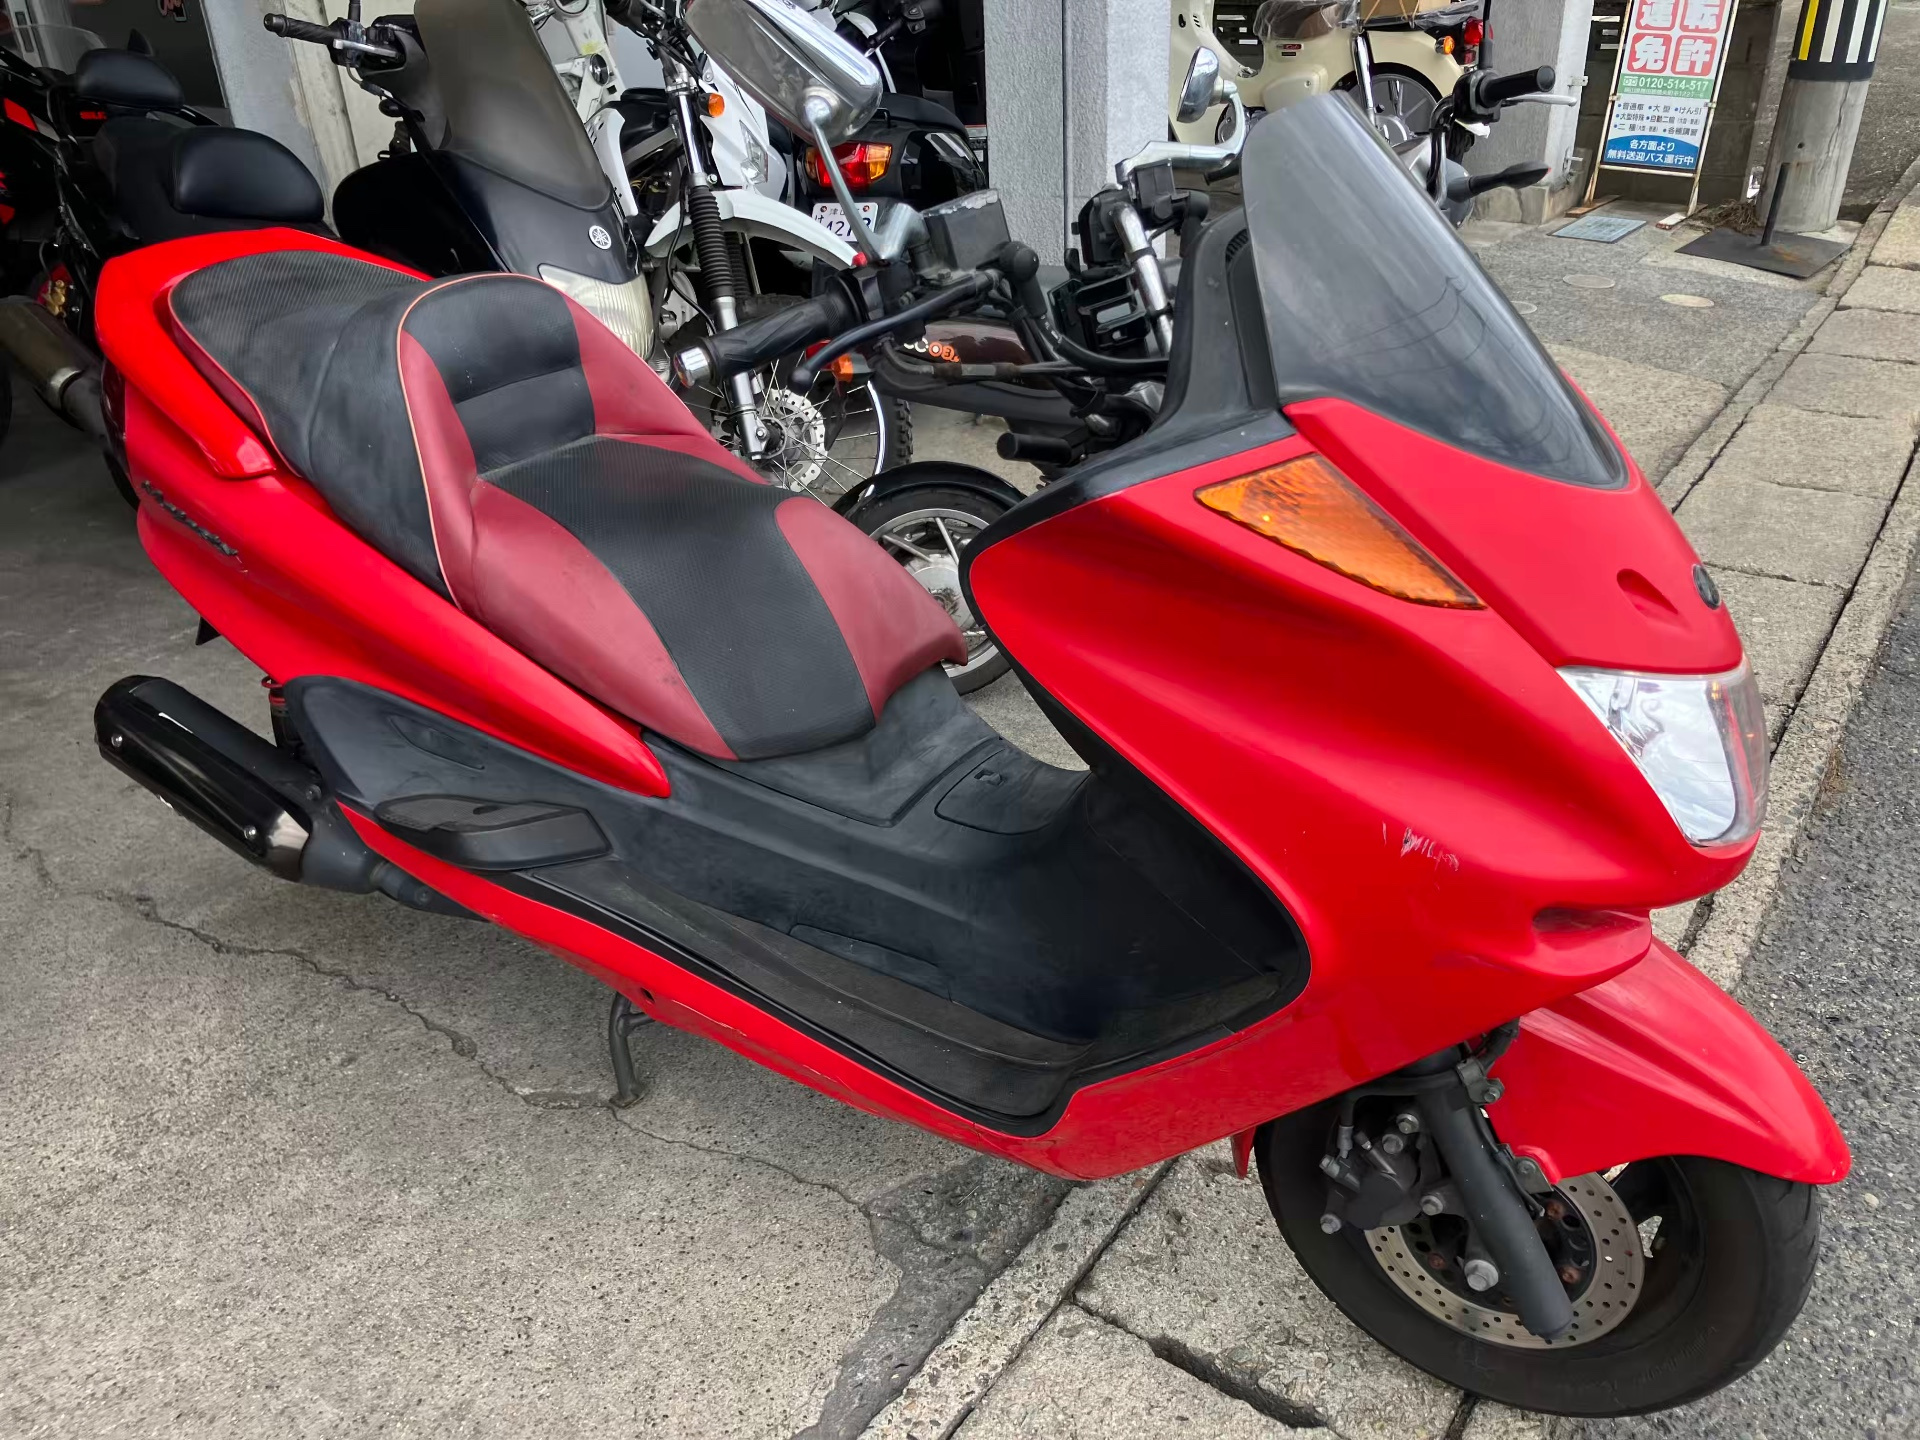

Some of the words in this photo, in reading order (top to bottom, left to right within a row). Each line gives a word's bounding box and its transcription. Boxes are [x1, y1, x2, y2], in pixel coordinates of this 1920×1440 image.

[1640, 0, 1720, 29] 運転
[1632, 36, 1713, 73] 免許
[1638, 77, 1709, 91] 0120-514-517
[1622, 102, 1644, 111] 普通車
[1678, 106, 1702, 115] けん引
[1620, 113, 1644, 121] 大型特殊
[1650, 115, 1675, 124] 自動二輪
[1668, 127, 1698, 136] 各種講習
[1630, 139, 1675, 151] 各方面より
[1607, 149, 1694, 165] 無料送迎バス運行中
